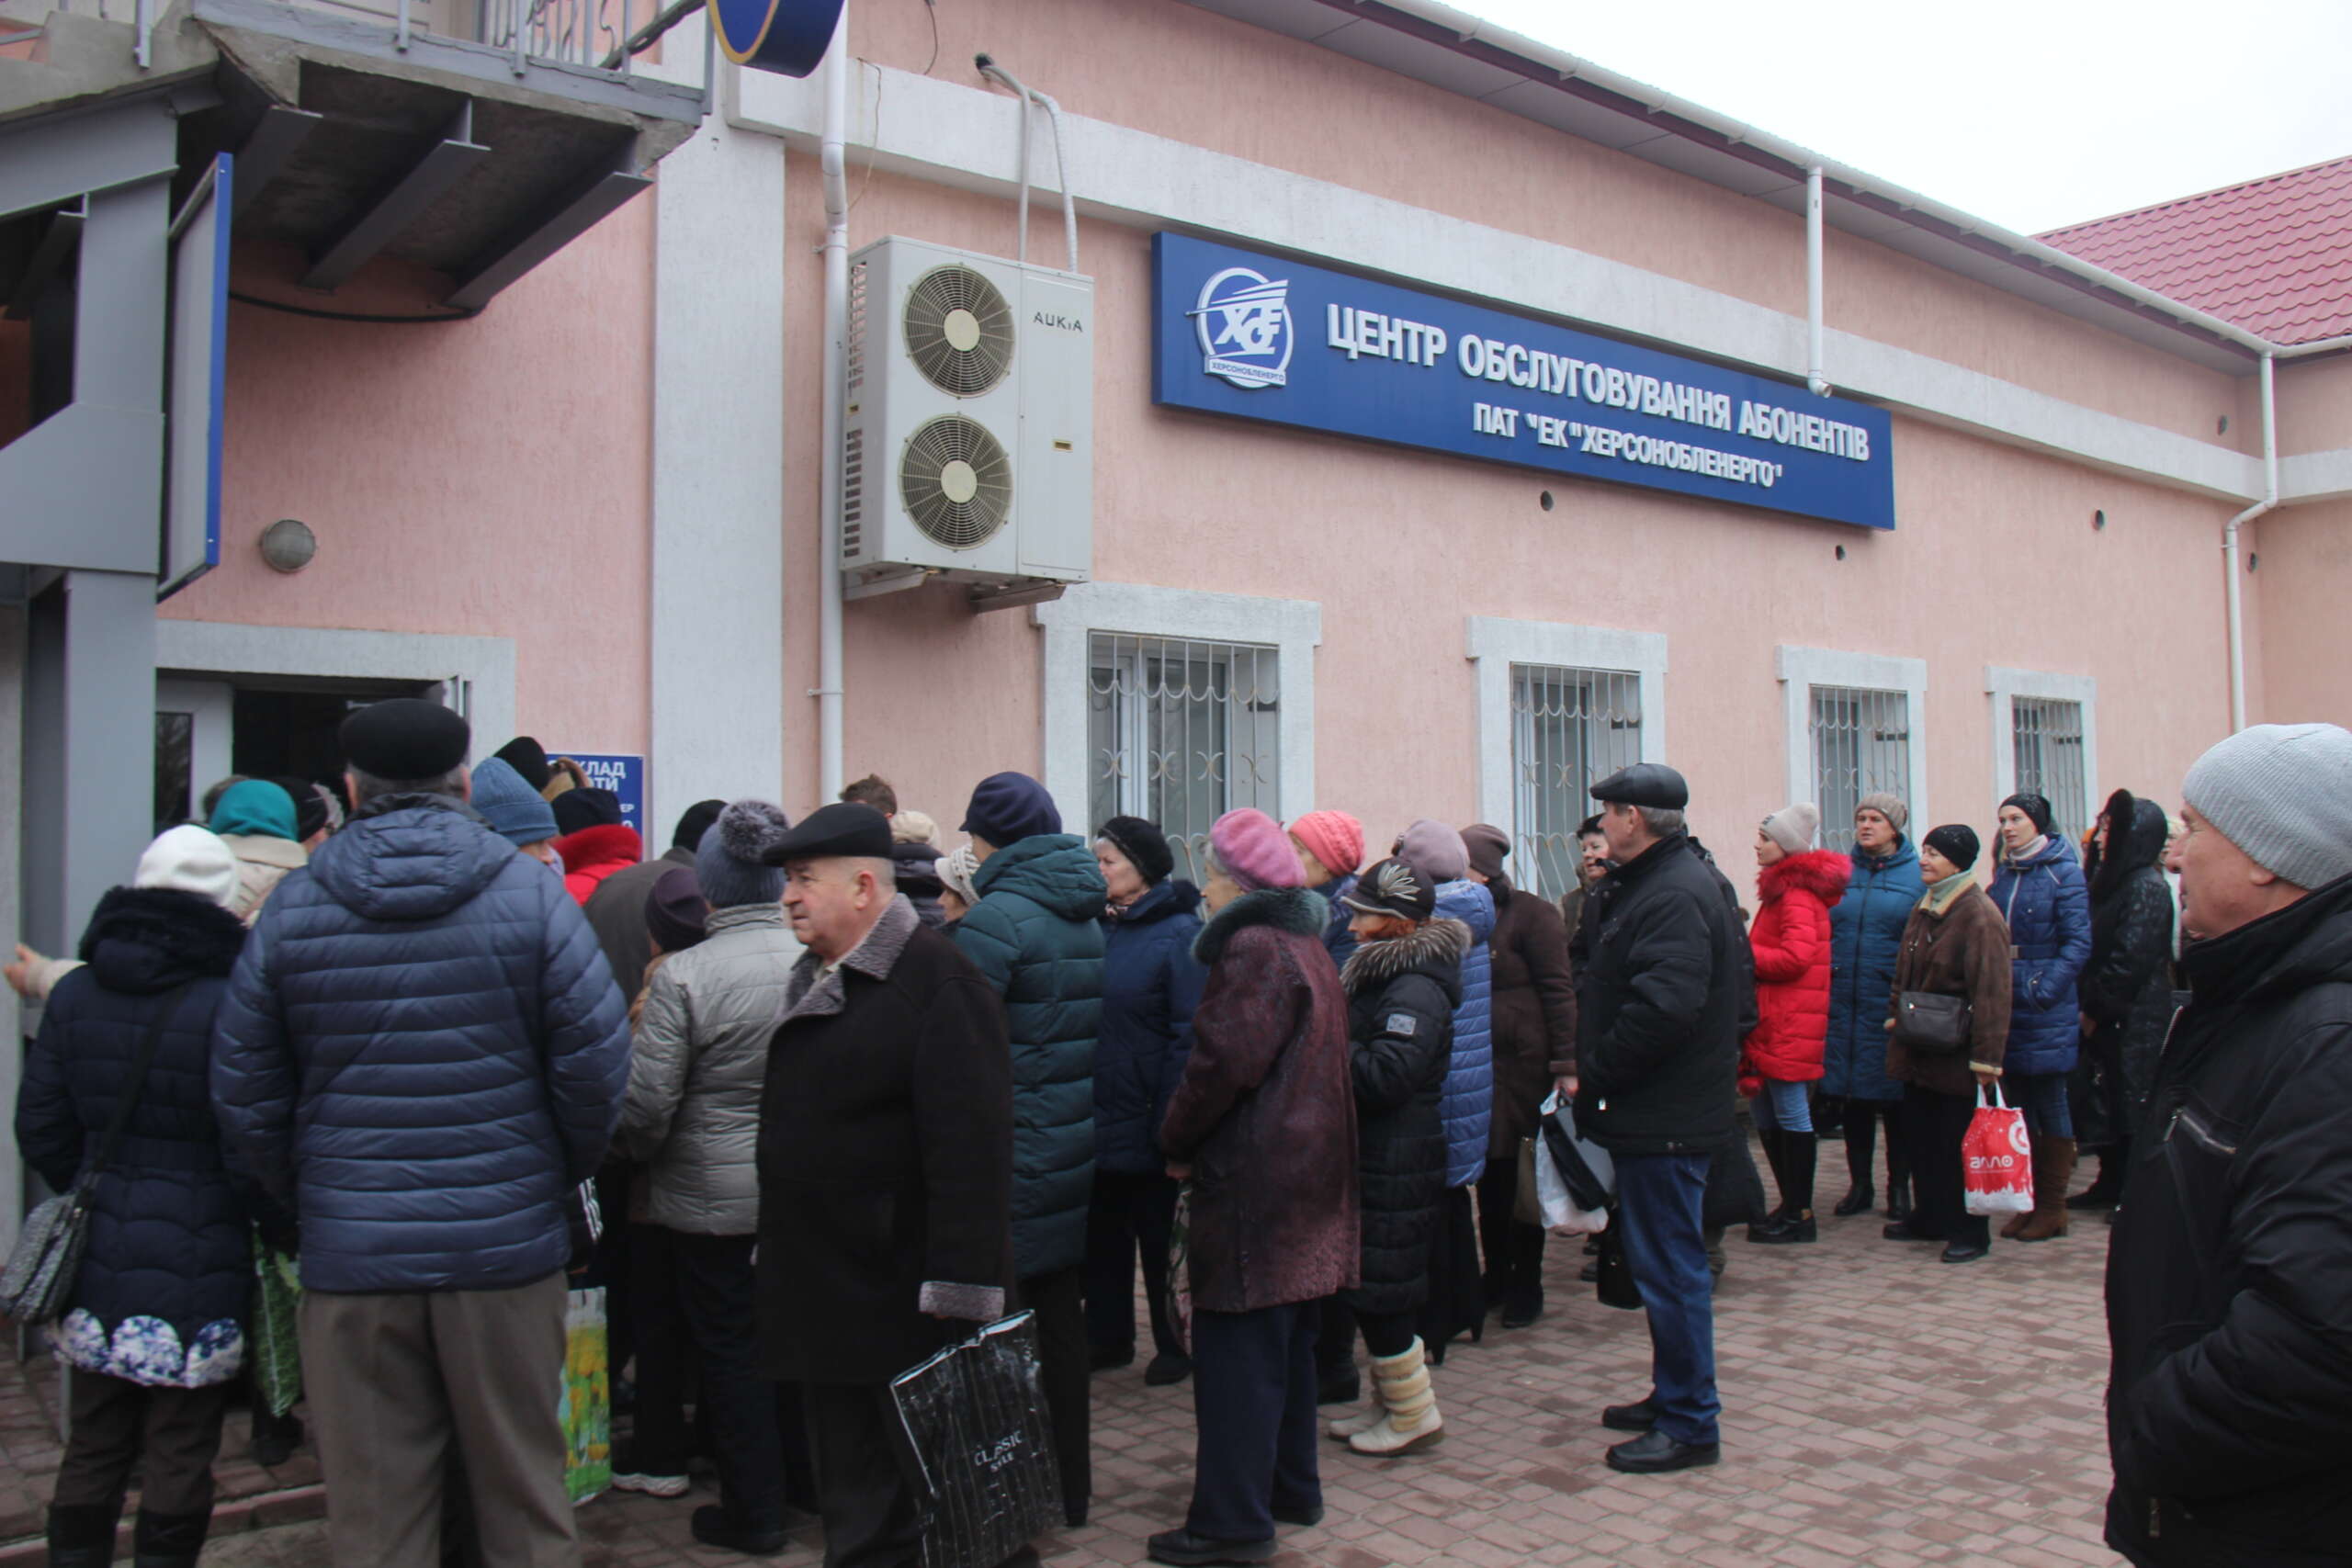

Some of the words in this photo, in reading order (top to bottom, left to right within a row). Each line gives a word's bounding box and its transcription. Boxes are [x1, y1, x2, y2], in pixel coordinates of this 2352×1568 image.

[1211, 362, 1284, 382] ХЕРСОНОБЛЕНЕРГО
[1328, 303, 1447, 367] ЦЕНТР
[1458, 334, 1731, 432] ОБСЛУГОВУВАННЯ
[1737, 400, 1871, 461] АБОНЕНТІВ
[1473, 402, 1519, 437] ПАТ
